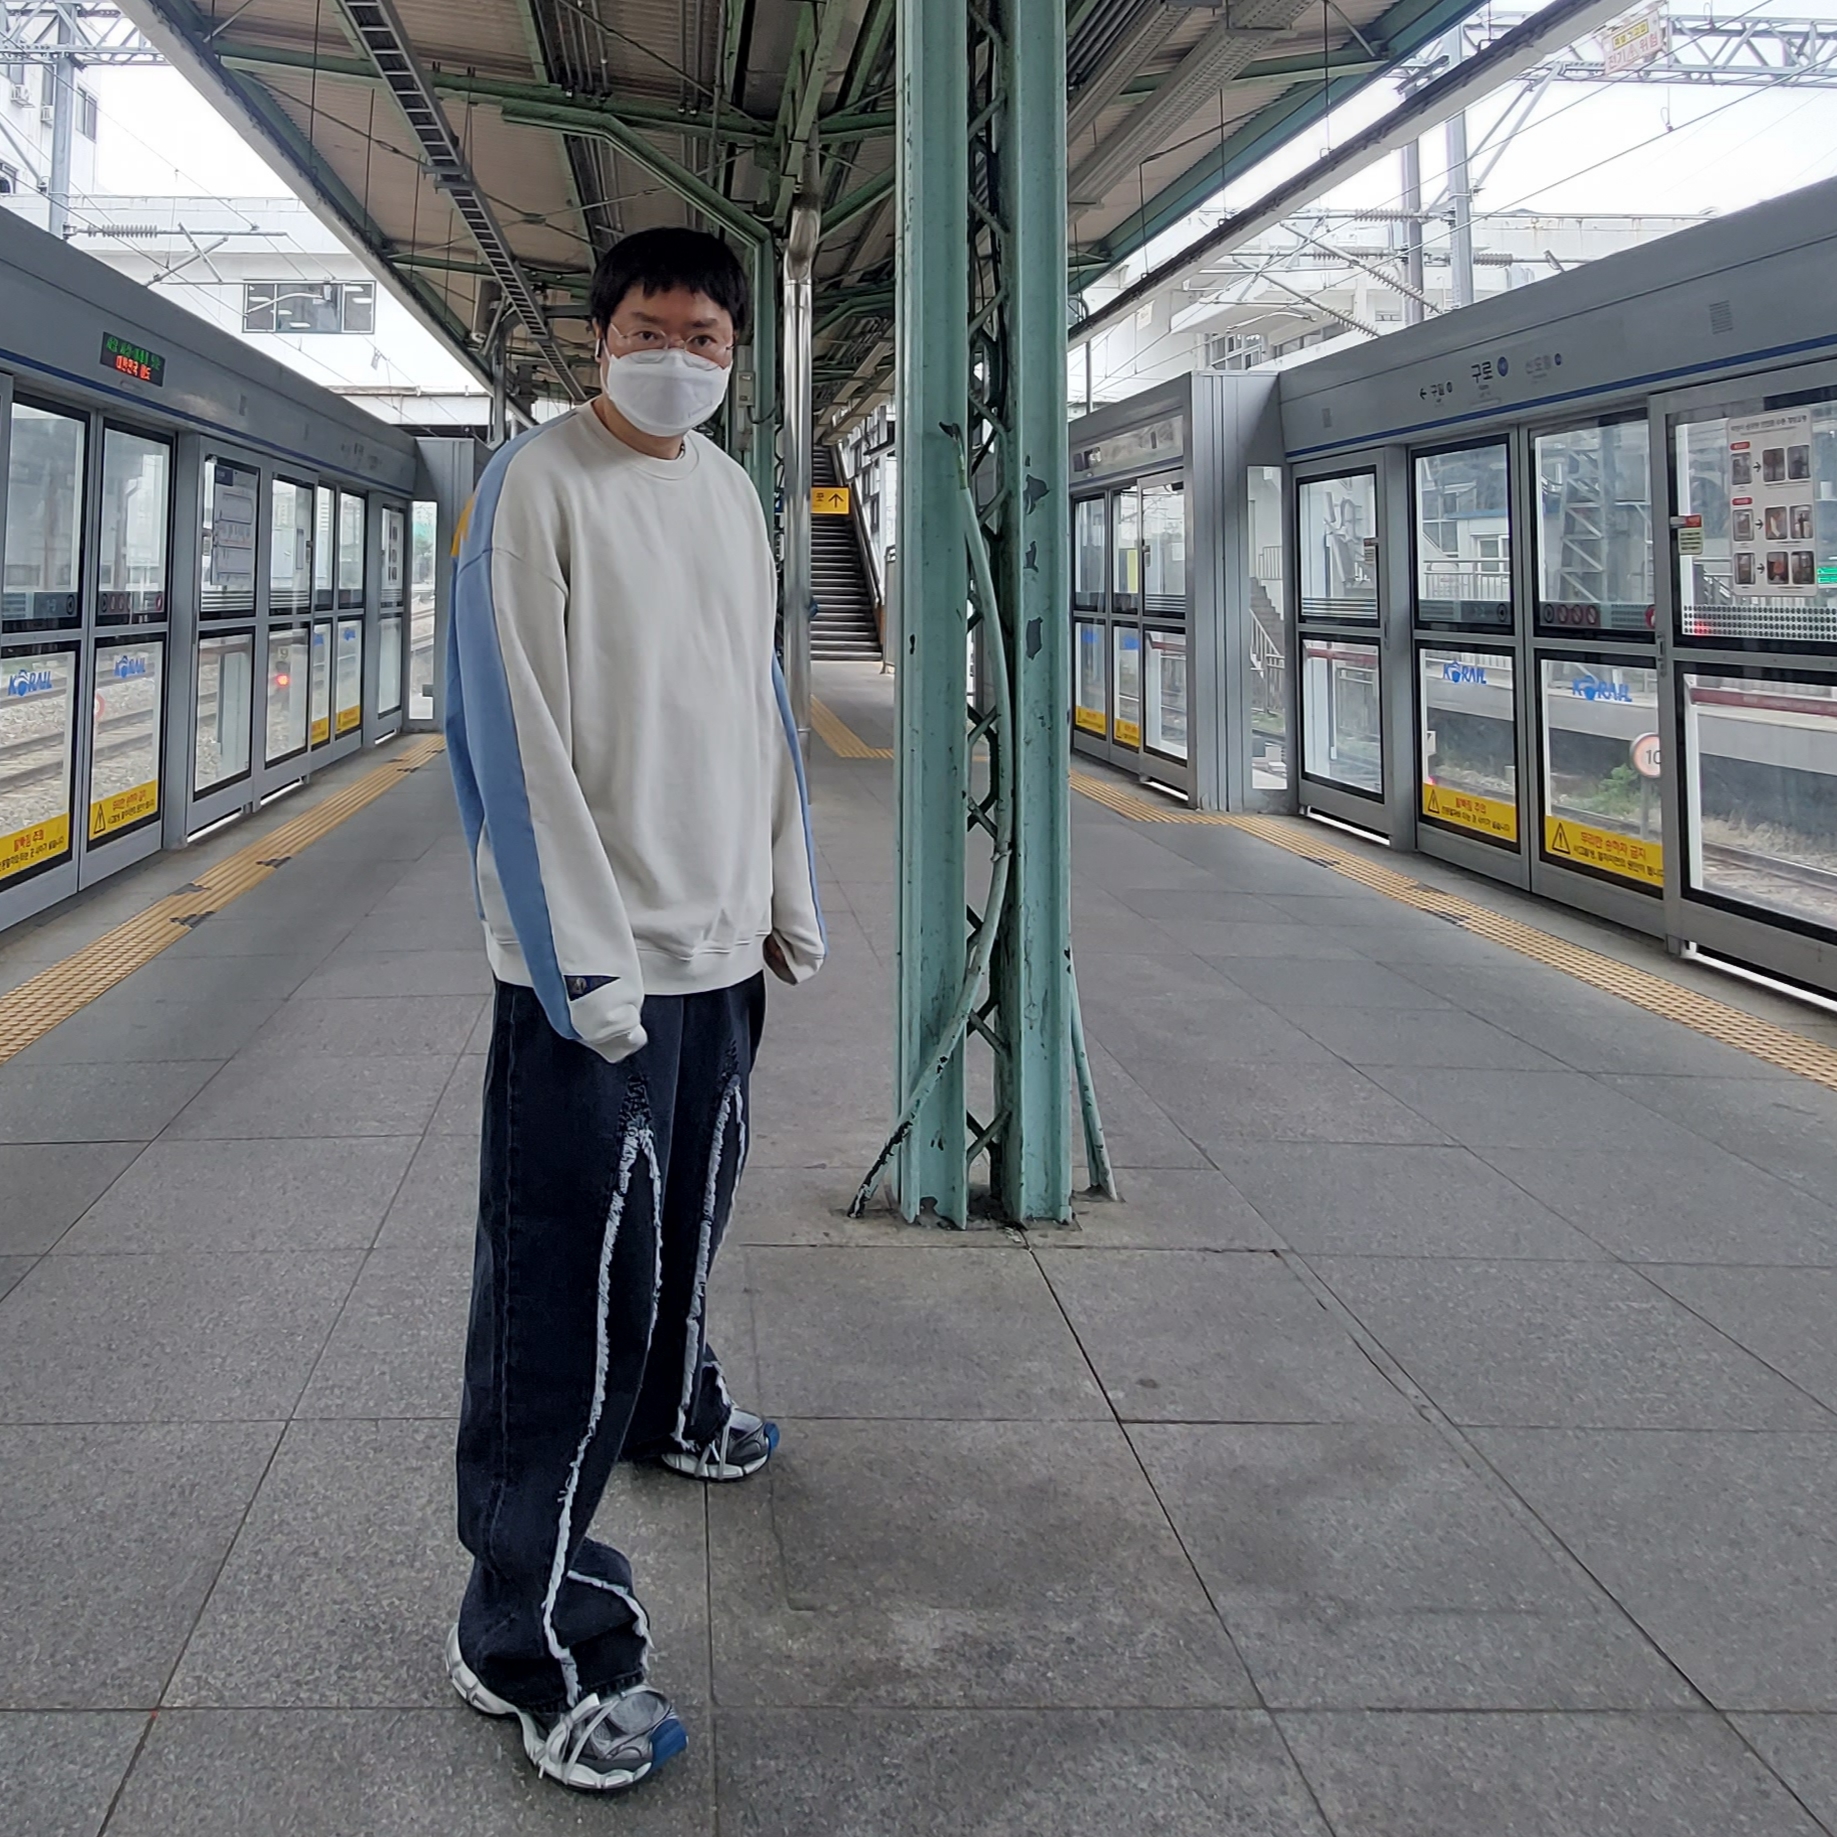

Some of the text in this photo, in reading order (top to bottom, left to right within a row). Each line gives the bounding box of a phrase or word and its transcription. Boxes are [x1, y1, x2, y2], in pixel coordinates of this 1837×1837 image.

[1608, 32, 1658, 69] 전기 위험
[1471, 360, 1493, 383] 구로
[8, 669, 53, 697] KORAIL
[1443, 660, 1487, 684] KORAIL
[1572, 675, 1633, 703] KORAIL
[1581, 831, 1603, 849] 무리한
[1630, 844, 1646, 860] 금지
